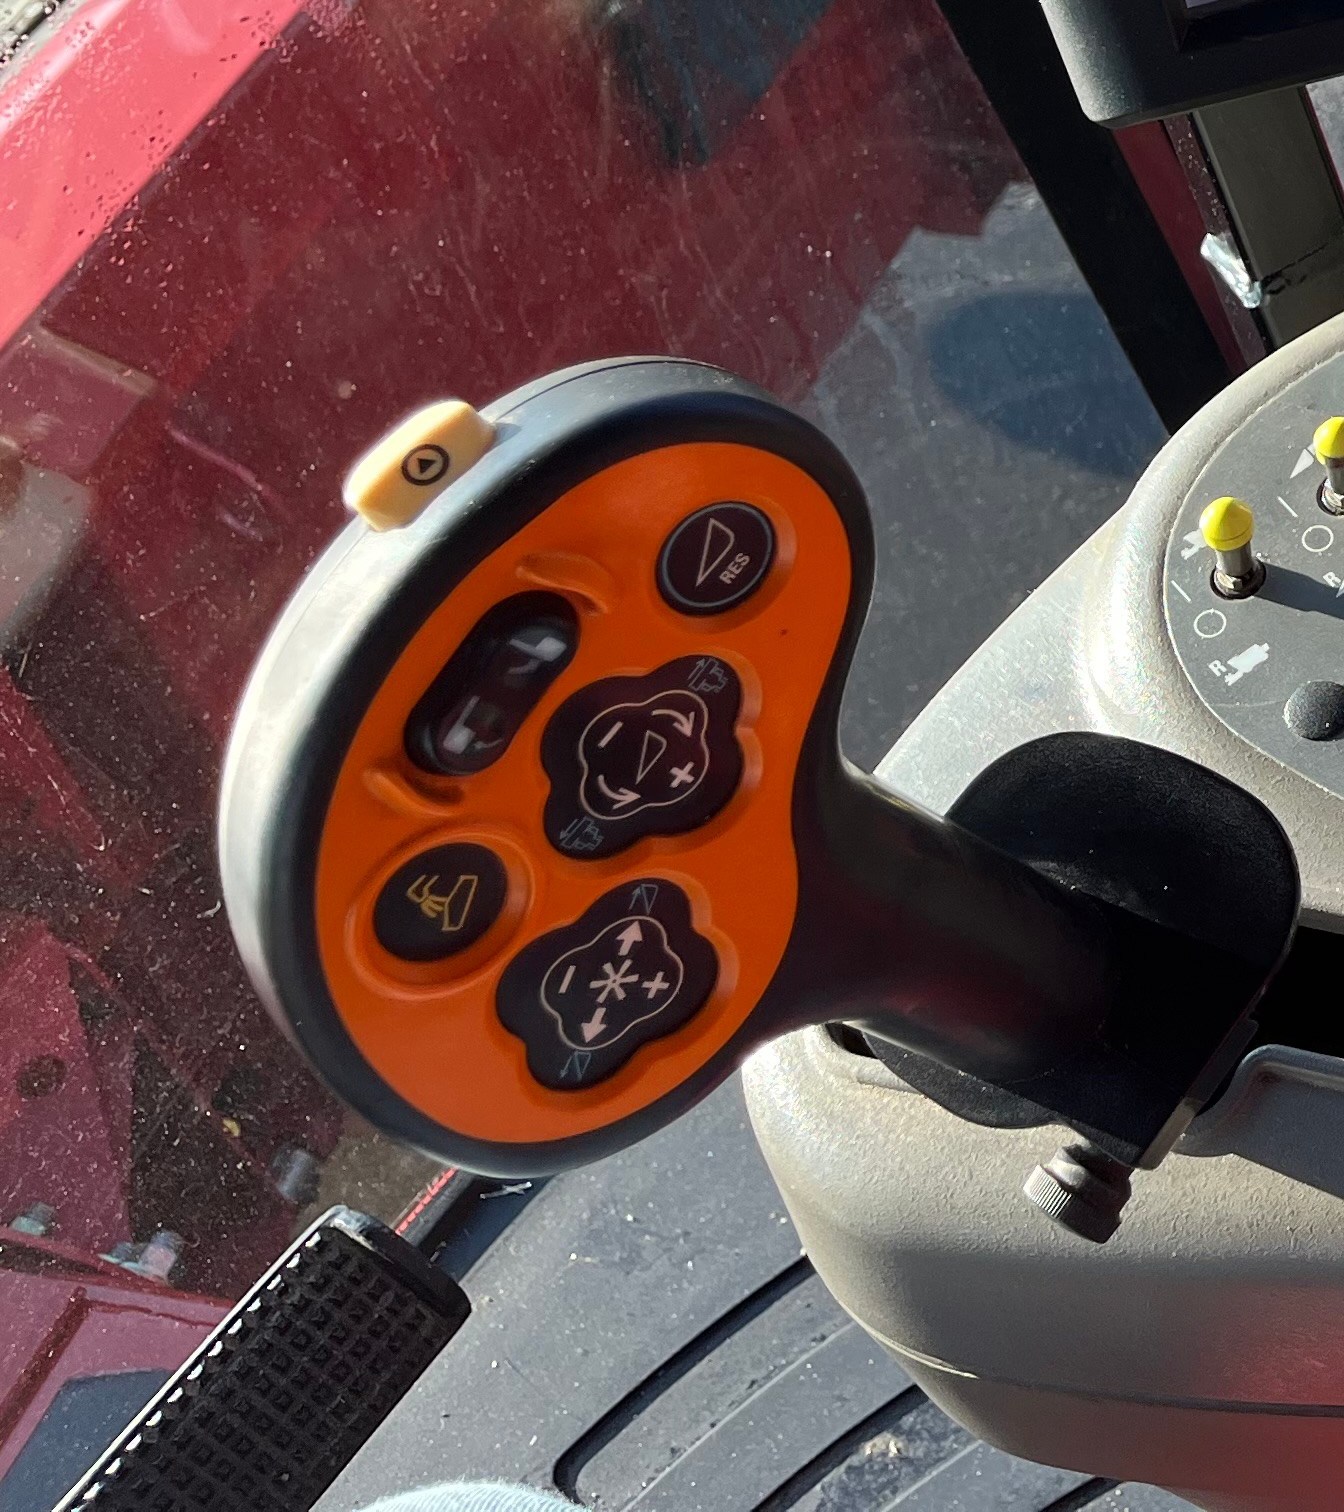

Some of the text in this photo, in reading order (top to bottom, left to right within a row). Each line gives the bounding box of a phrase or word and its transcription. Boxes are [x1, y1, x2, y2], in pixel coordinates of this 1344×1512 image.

[718, 552, 751, 585] RES
[1322, 571, 1342, 588] R
[1206, 658, 1228, 677] R
